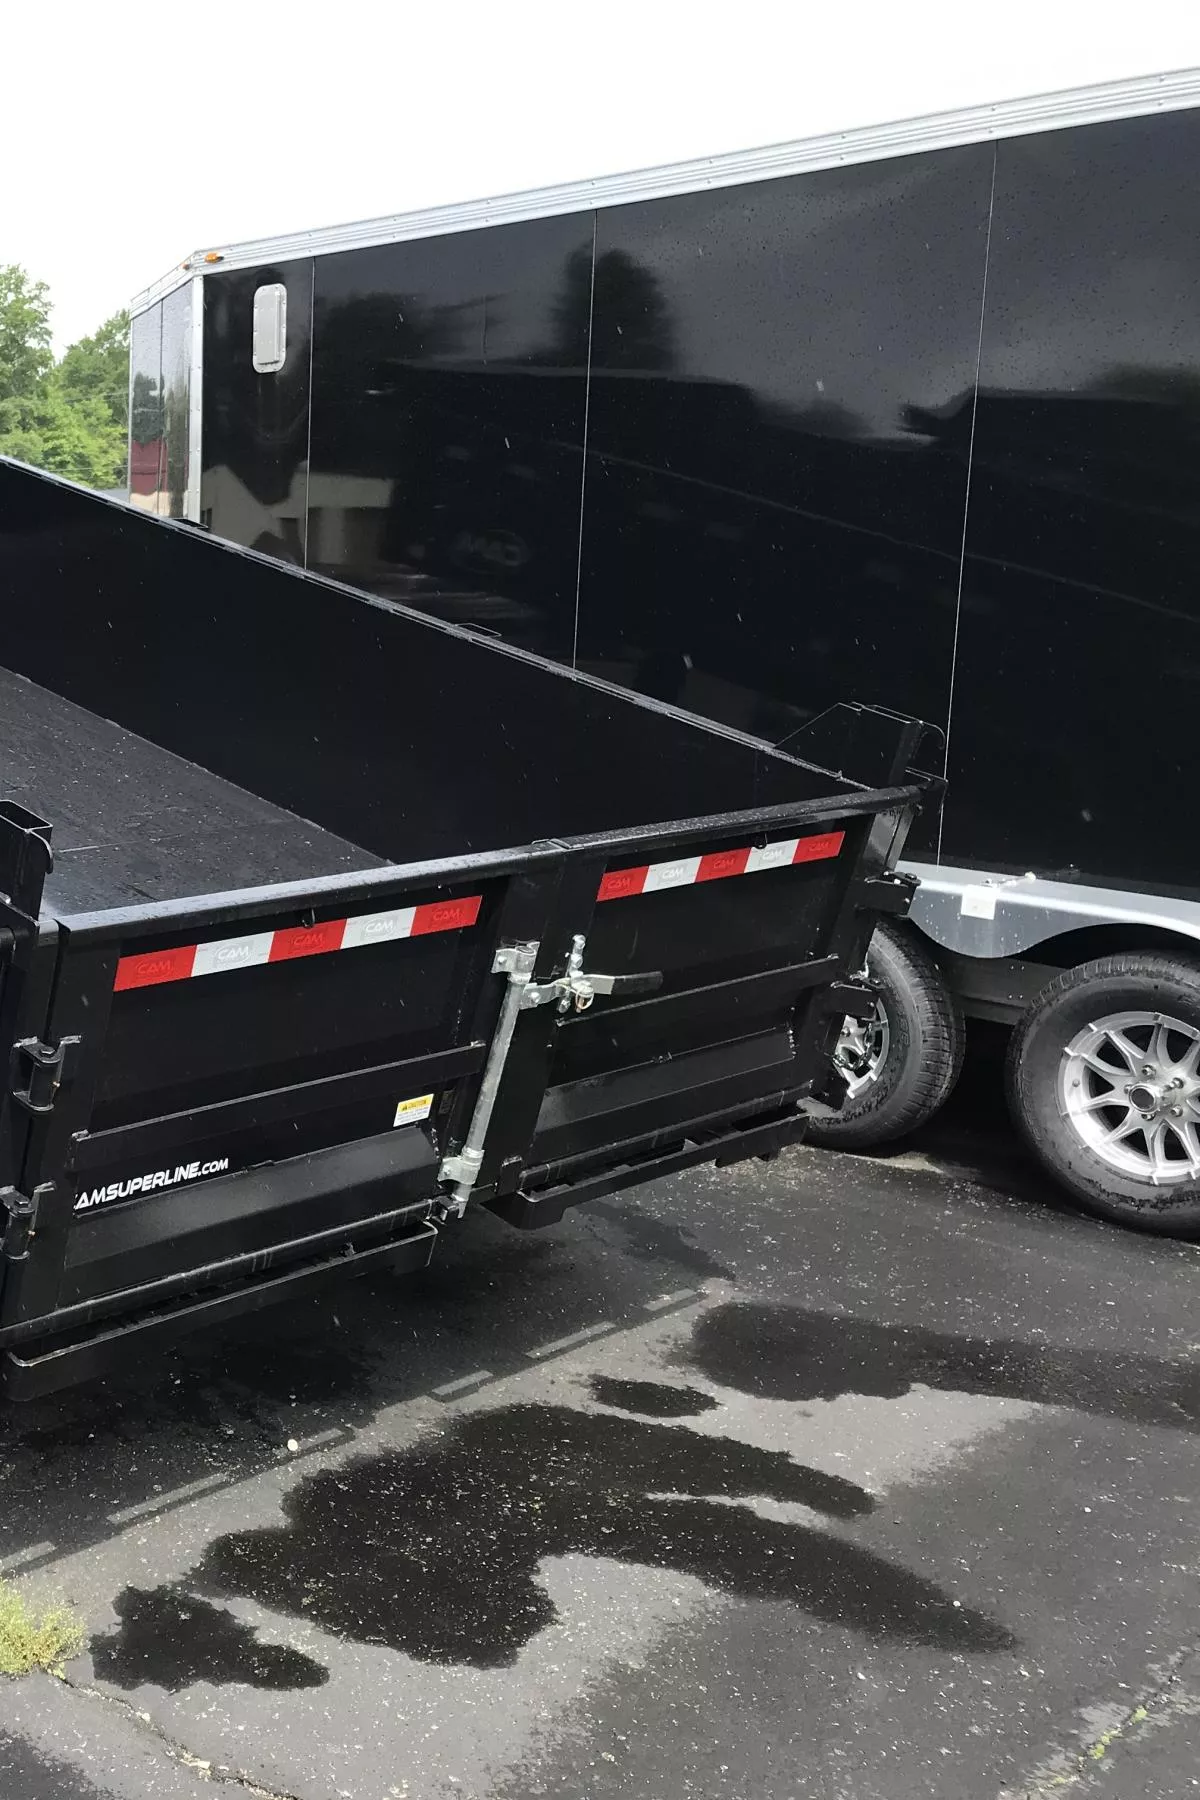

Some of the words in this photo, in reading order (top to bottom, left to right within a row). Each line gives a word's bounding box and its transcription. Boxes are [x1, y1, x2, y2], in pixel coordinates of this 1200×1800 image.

[662, 867, 684, 880] CAM
[137, 959, 171, 974] CAM
[217, 946, 249, 960] CAM
[293, 933, 323, 946] CAM
[365, 919, 394, 933] CAM
[433, 908, 461, 921] CAM
[74, 1158, 229, 1210] AMSUPERLINE.COM
